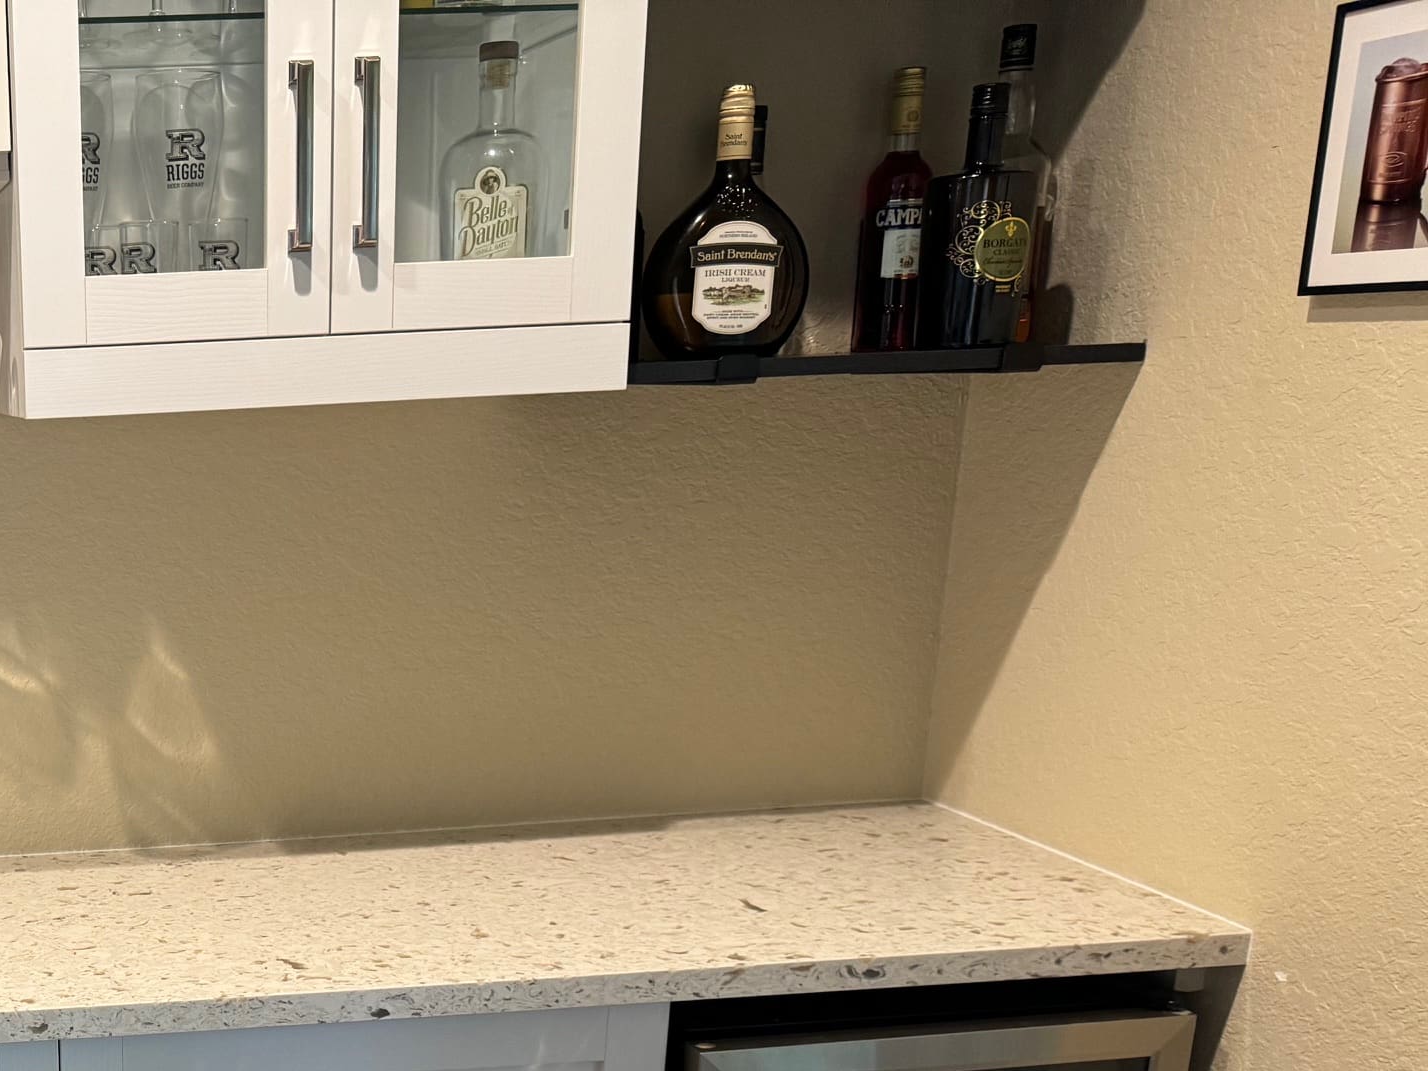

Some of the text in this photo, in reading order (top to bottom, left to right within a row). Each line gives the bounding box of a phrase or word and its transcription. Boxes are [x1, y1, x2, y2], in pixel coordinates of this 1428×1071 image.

[166, 128, 206, 162] R
[166, 162, 205, 181] RIGGS
[464, 196, 507, 228] Belle
[458, 216, 519, 257] Dayton
[121, 242, 157, 274] R
[198, 240, 240, 271] R
[697, 249, 726, 262] Saint
[705, 268, 766, 277] IRISH CREAM
